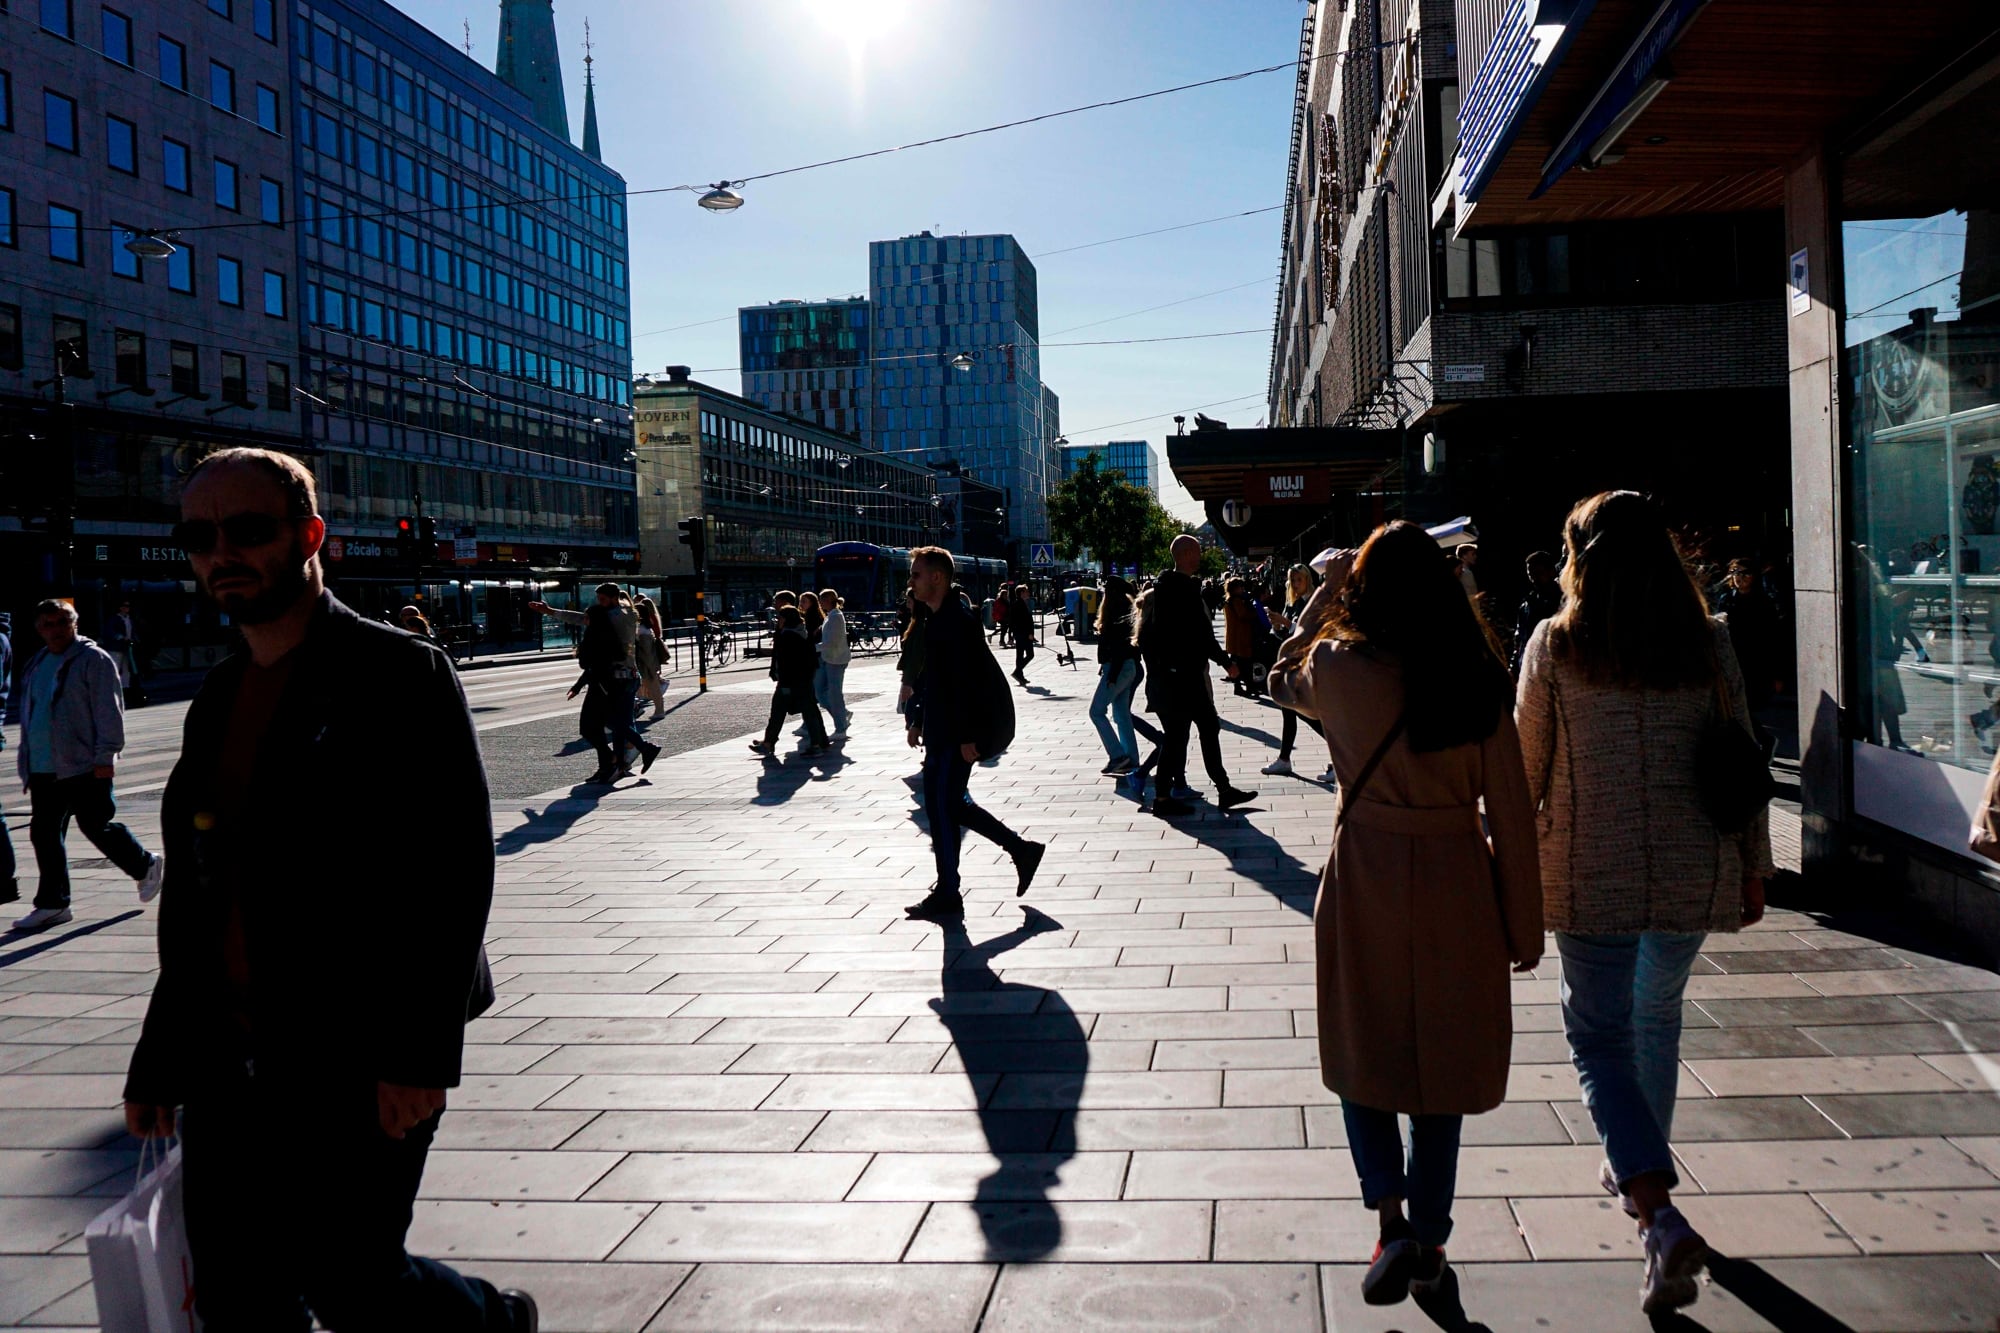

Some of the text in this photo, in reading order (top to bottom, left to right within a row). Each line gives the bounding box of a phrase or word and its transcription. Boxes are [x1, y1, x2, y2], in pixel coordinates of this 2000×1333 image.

[1270, 475, 1304, 491] MUJI
[141, 547, 187, 561] RESTA
[560, 551, 568, 565] 29
